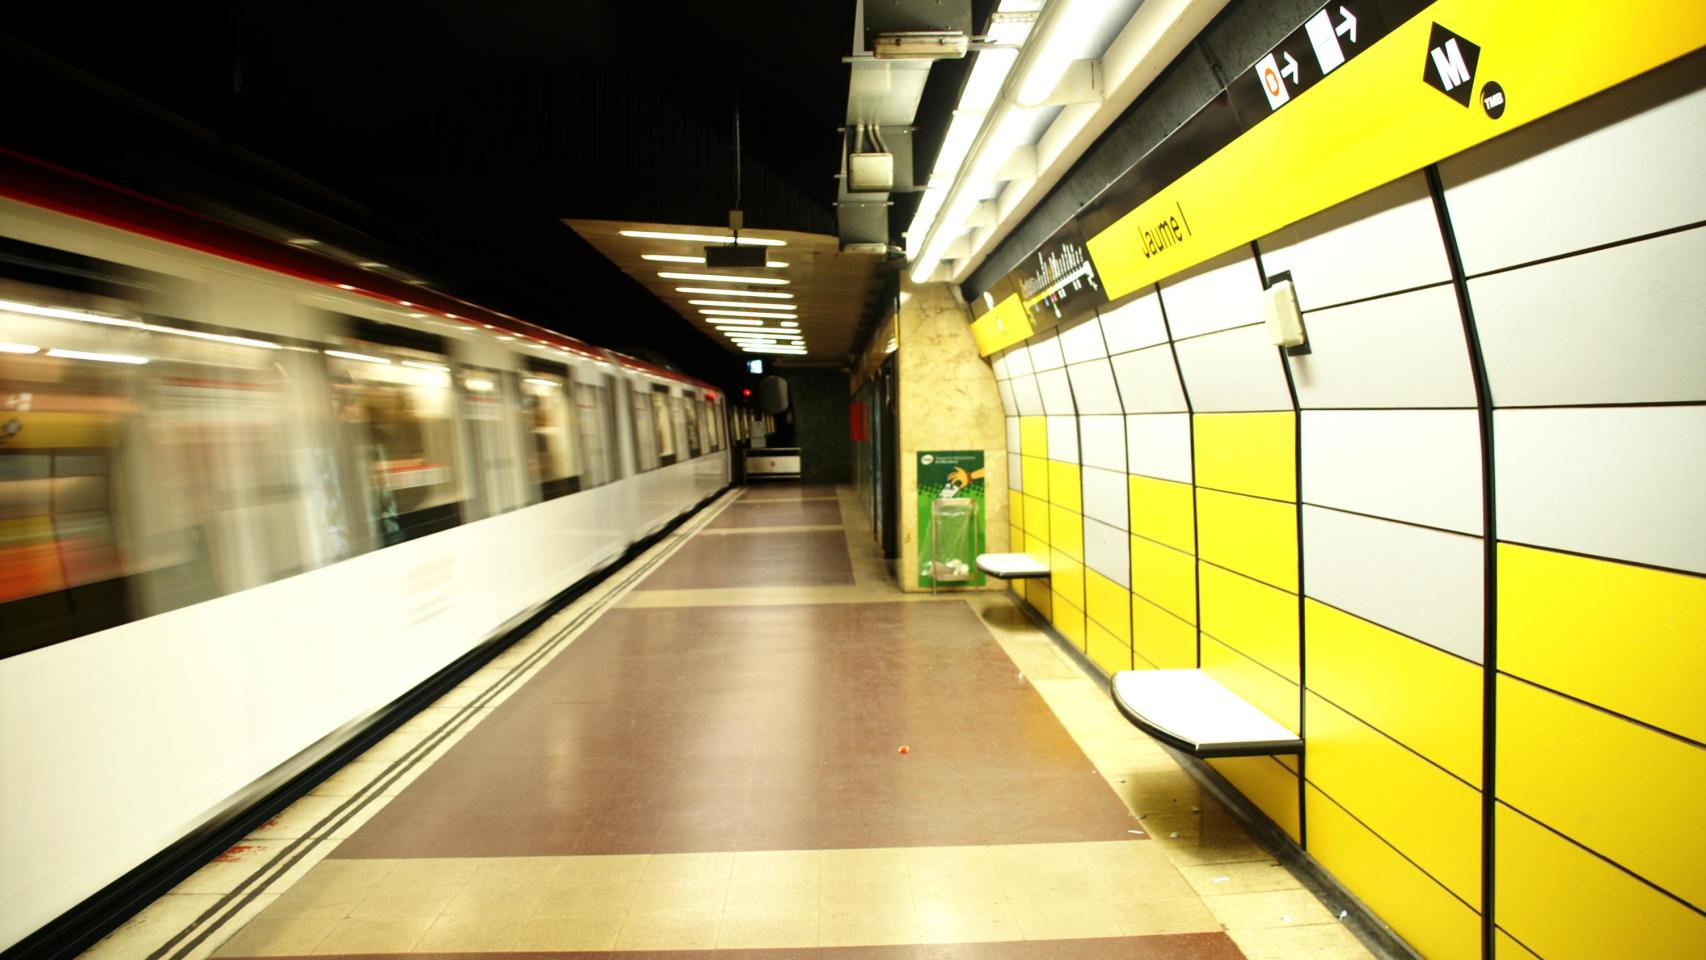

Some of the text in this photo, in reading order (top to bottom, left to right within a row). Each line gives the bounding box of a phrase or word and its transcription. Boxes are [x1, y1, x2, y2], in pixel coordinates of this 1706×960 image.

[1430, 37, 1470, 91] M
[1484, 92, 1503, 110] TMB
[1137, 201, 1192, 258] Jaume I
